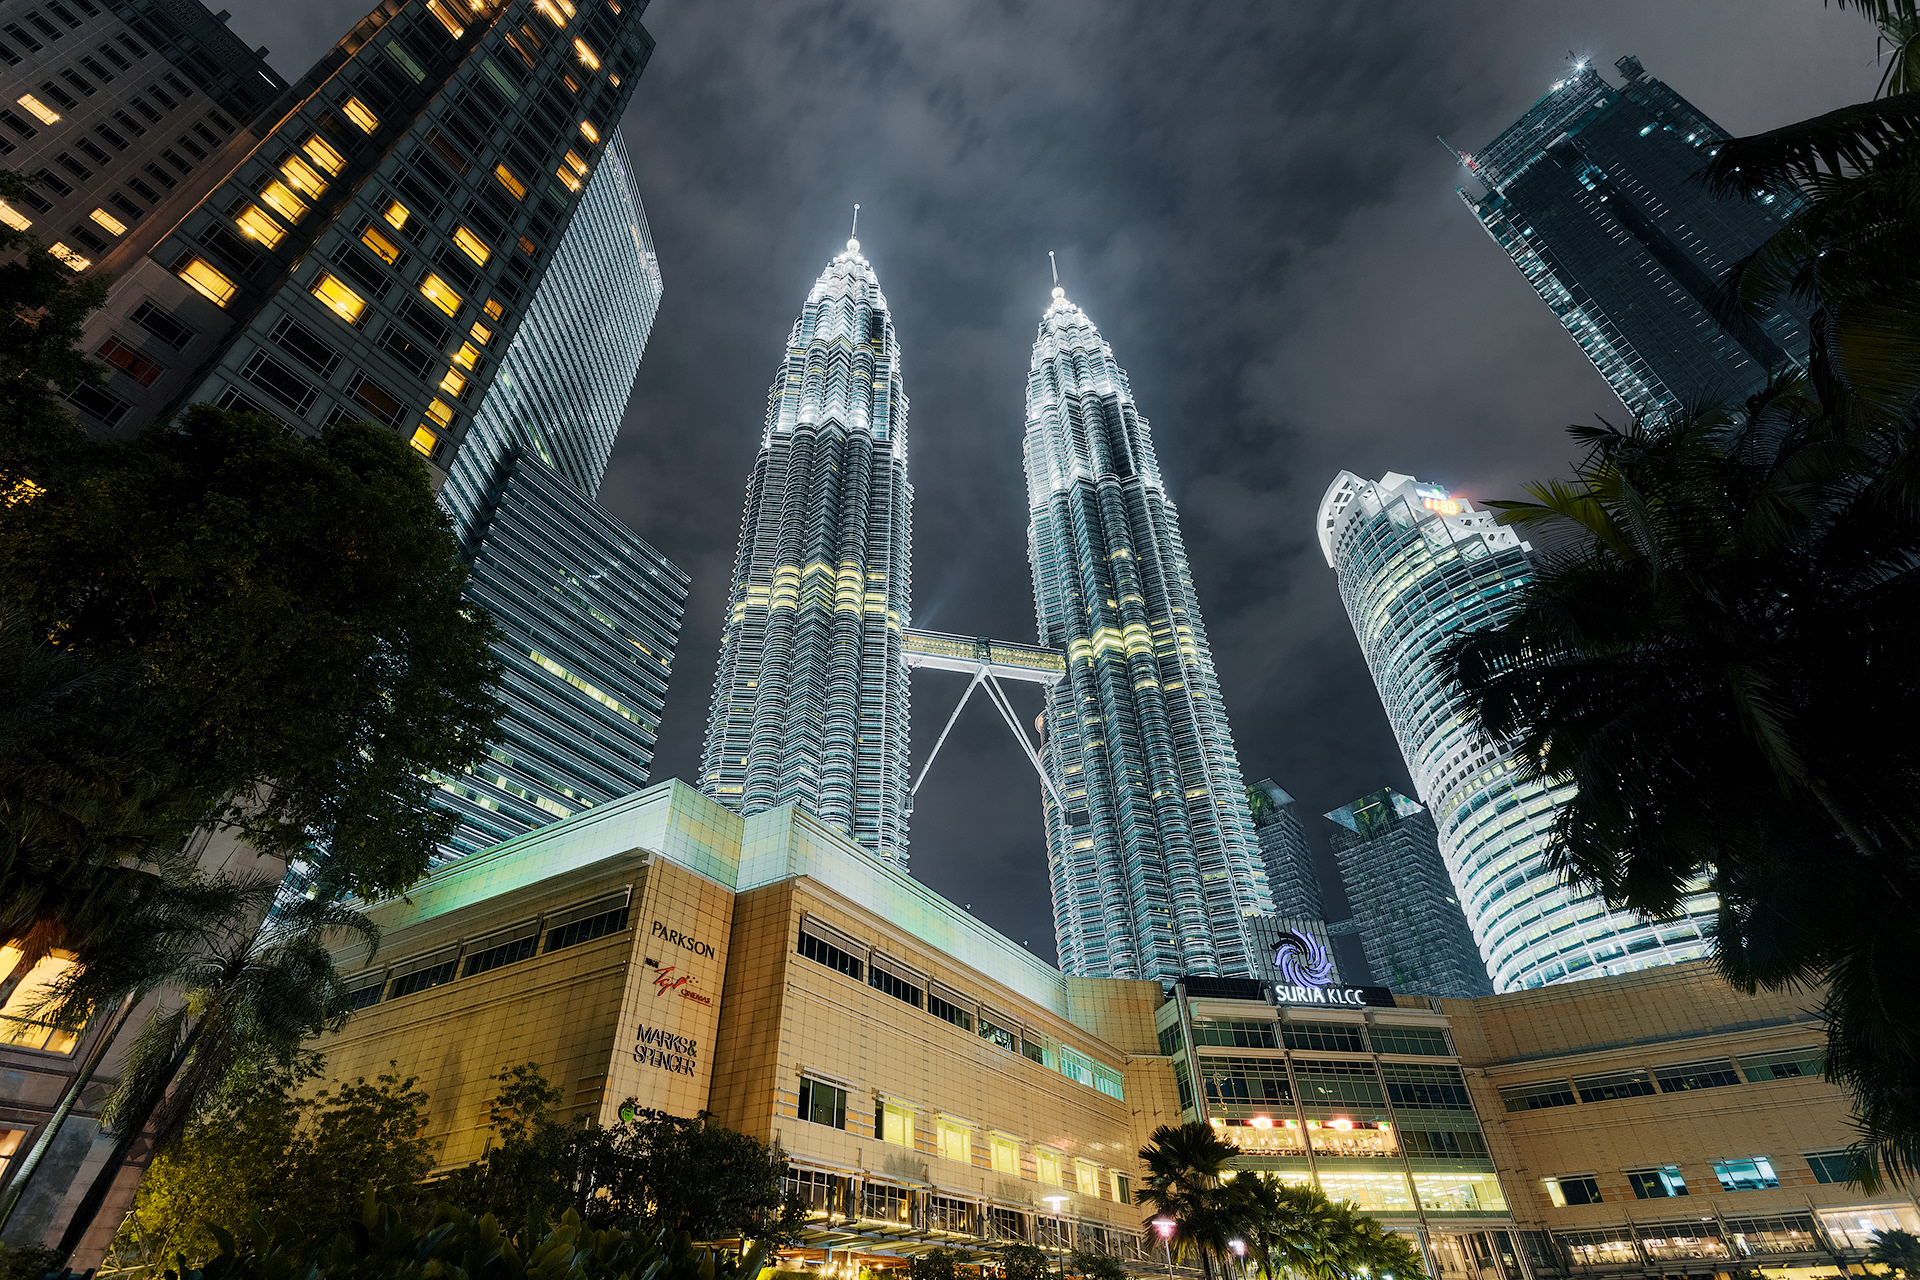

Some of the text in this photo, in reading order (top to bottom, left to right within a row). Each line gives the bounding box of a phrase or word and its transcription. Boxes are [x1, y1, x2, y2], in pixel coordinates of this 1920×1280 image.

[652, 921, 715, 959] PARKSON
[681, 989, 711, 1003] CINEMAS
[1275, 985, 1366, 1004] SURIA KLCC
[633, 1044, 696, 1077] SPENCER
